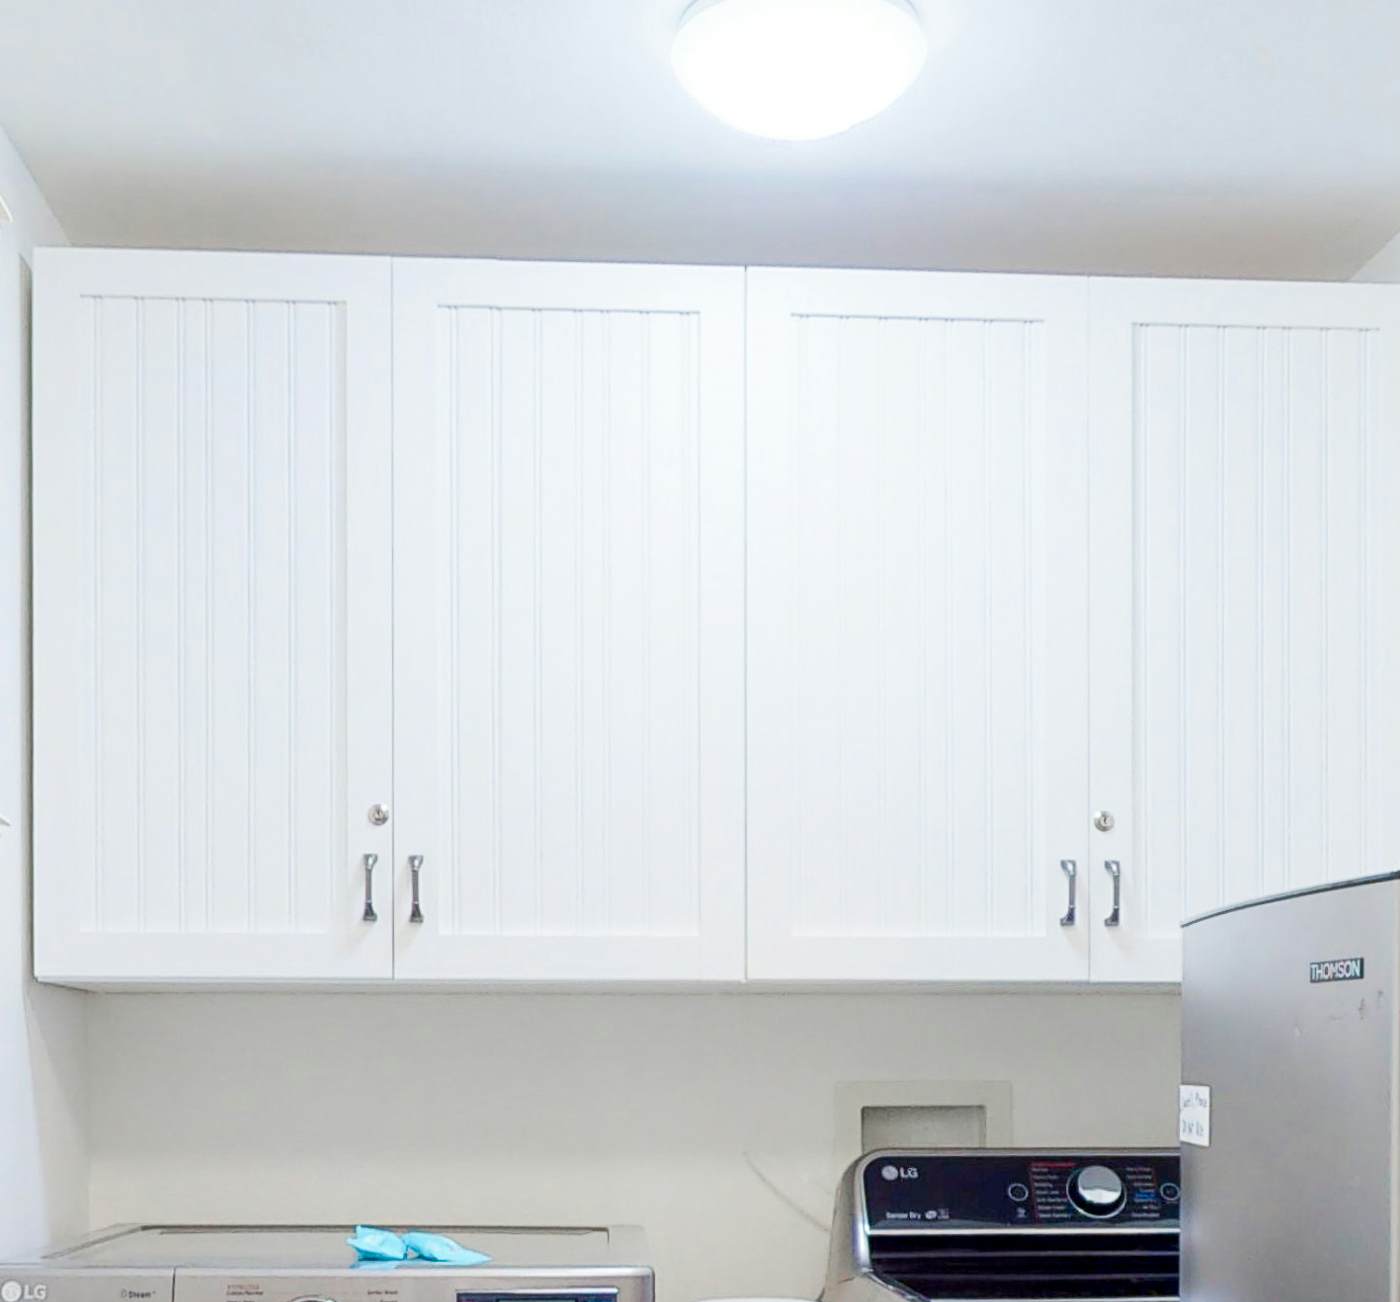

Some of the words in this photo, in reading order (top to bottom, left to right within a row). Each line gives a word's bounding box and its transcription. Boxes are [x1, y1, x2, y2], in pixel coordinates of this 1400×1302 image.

[1311, 960, 1360, 980] THOMSON
[900, 1167, 918, 1178] LG
[23, 1284, 47, 1300] LG
